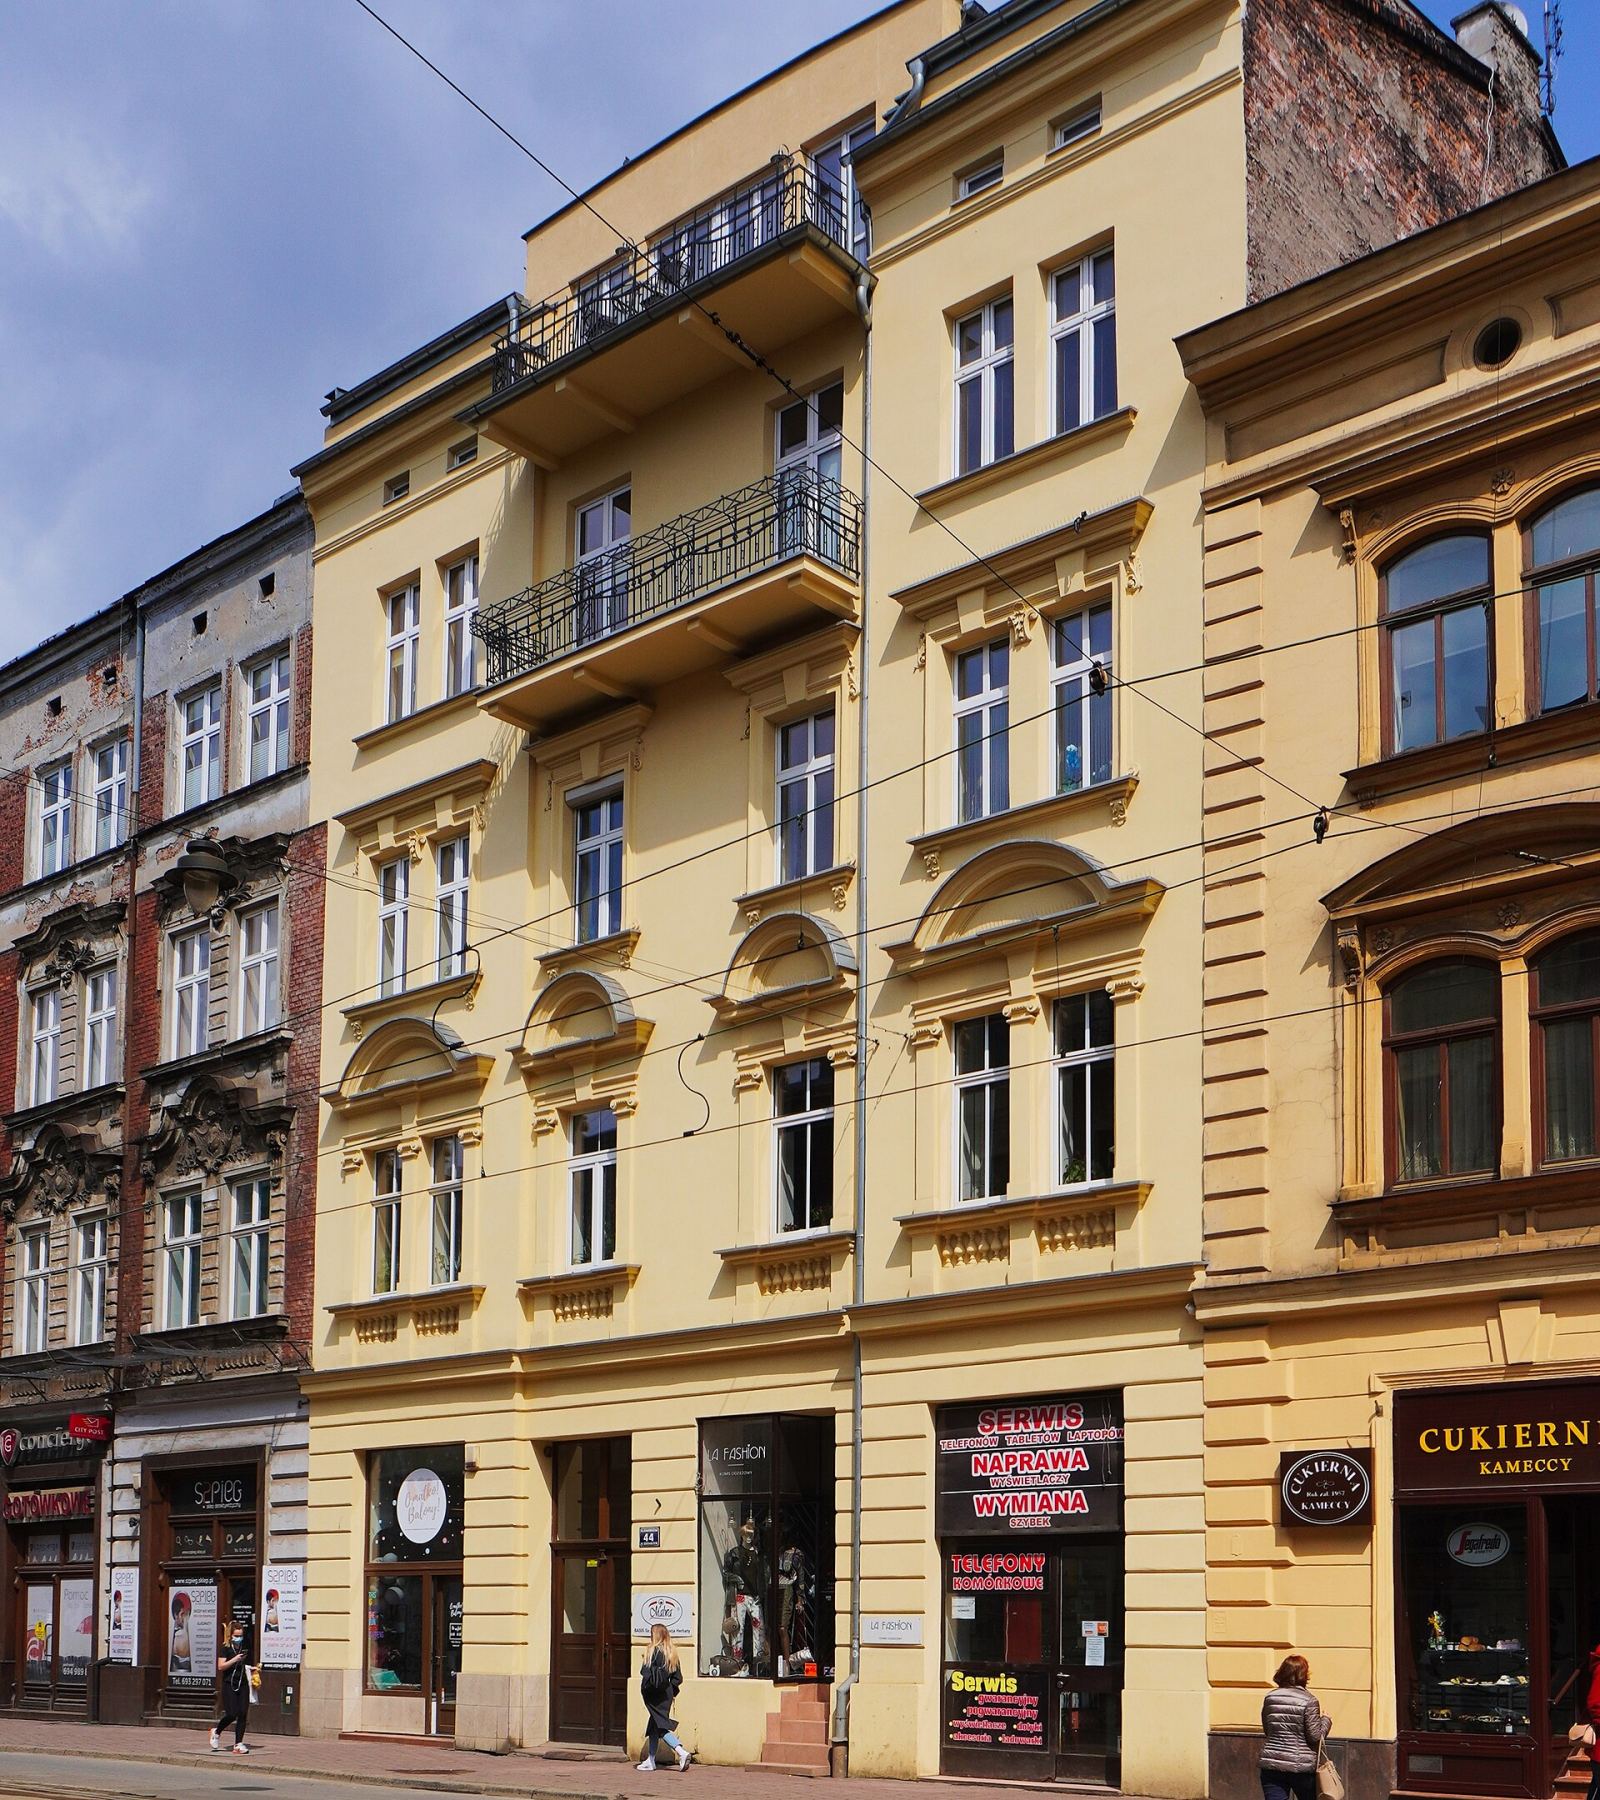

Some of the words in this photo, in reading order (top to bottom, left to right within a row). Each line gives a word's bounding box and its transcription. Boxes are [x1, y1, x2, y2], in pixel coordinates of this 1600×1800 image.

[978, 1403, 1084, 1435] SERWIS
[940, 1434, 999, 1450] TELEFONÓW
[1005, 1431, 1060, 1446] TABLETÓW
[1067, 1425, 1124, 1442] LAPTOPÓW
[1418, 1419, 1600, 1454] CUKIERN
[707, 1447, 719, 1461] LA
[972, 1447, 1089, 1476] NAPRAWA
[1479, 1457, 1573, 1475] KAMECCY
[990, 1472, 1070, 1488] WYŚWIETLACZY
[1290, 1460, 1361, 1495] CUKIERNIA
[973, 1490, 1089, 1517] WYMIANA
[1301, 1501, 1351, 1510] KAMECCY
[1009, 1516, 1051, 1528] SZYBEK
[643, 1532, 654, 1542] 44
[952, 1553, 1046, 1574] TELEFONY
[952, 1574, 1044, 1591] KOMÓRKOWE
[870, 1621, 879, 1631] LA
[951, 1671, 1018, 1693] Serwis
[978, 1693, 1039, 1707] gwarancyjny
